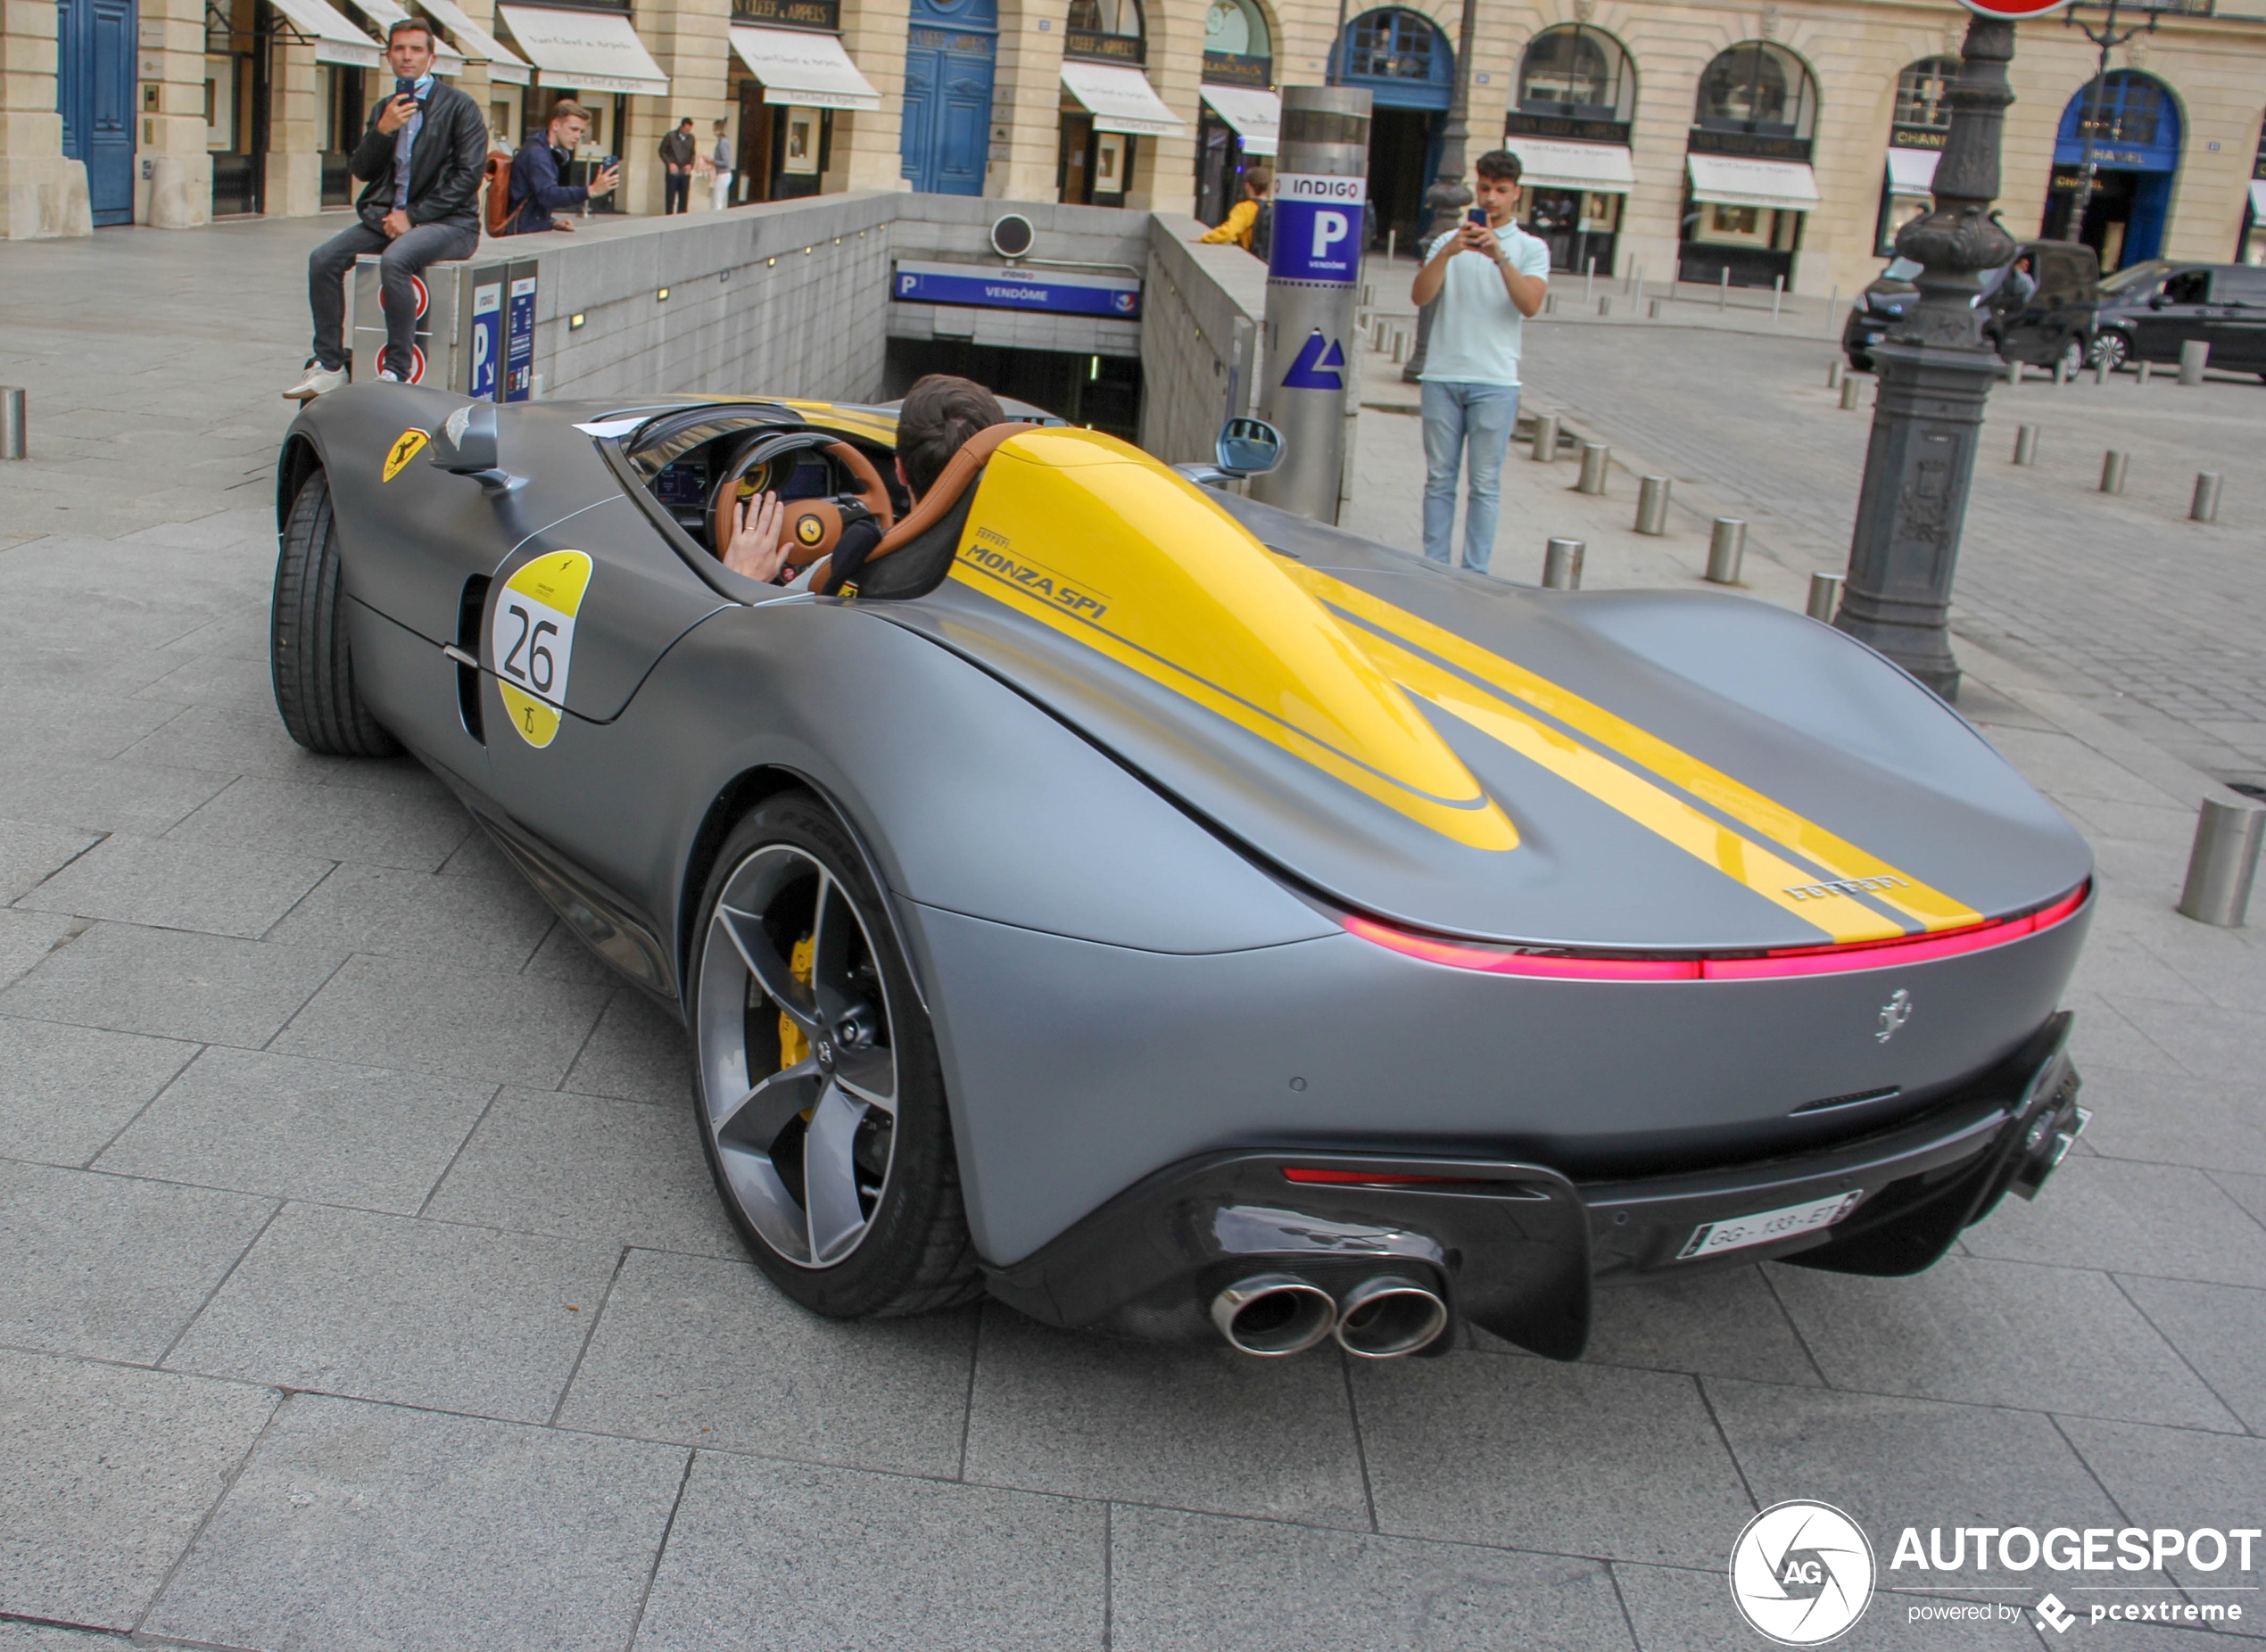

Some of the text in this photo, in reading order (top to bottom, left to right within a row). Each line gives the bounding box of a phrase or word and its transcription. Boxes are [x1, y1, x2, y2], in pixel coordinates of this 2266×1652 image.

[746, 0, 777, 16] CLEEF
[788, 4, 826, 22] ARPELS
[2091, 148, 2145, 164] HANEL
[1294, 179, 1359, 197] INDIGO
[2055, 176, 2103, 190] CHAEL
[1311, 210, 1348, 258] P
[1308, 260, 1347, 270] VENDÔME
[901, 276, 916, 293] P
[985, 286, 1049, 301] VENDÔME
[473, 322, 489, 391] P
[965, 544, 1107, 620] MONZA SP1
[504, 604, 558, 693] 26
